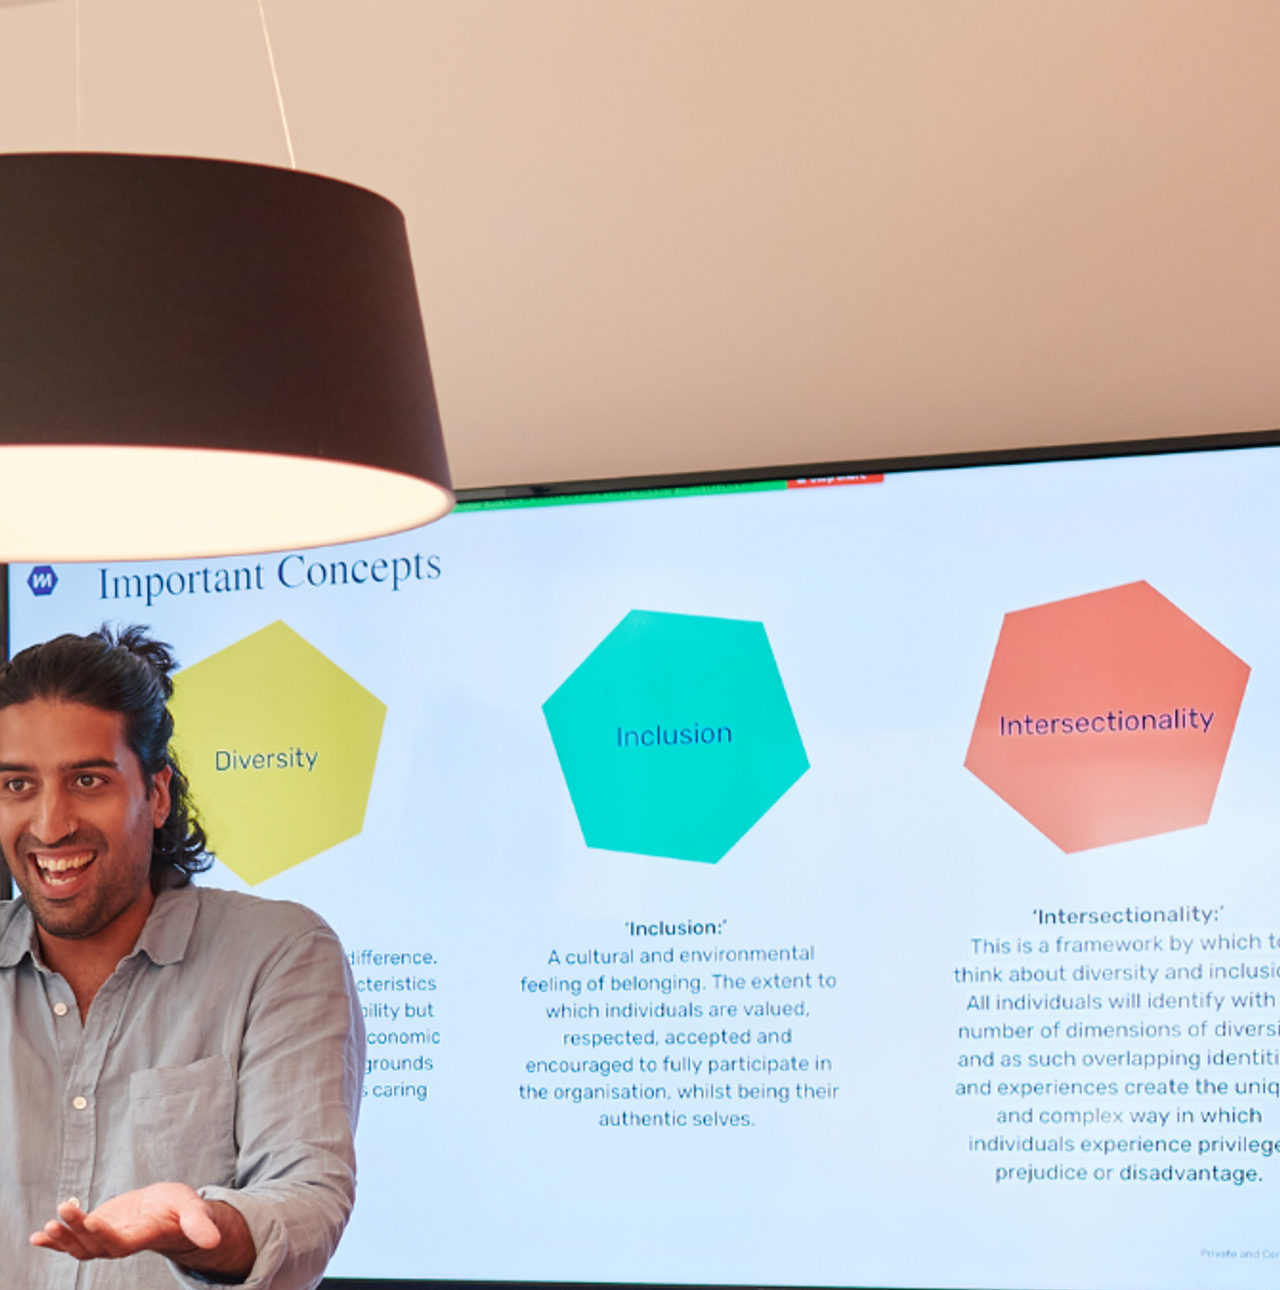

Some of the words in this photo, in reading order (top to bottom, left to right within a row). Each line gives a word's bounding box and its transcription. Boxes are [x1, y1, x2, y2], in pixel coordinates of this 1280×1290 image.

[98, 562, 265, 607] Important
[278, 553, 441, 591] Concepts
[1001, 708, 1214, 736] Intersectionality
[616, 722, 734, 750] Inclusion
[216, 747, 318, 772] Diversity
[971, 938, 1011, 954] This
[1017, 938, 1033, 954] is
[1038, 940, 1049, 954] a
[1056, 936, 1163, 953] framework
[1170, 935, 1194, 954] by
[1200, 933, 1261, 950] which
[548, 950, 561, 965] A
[566, 949, 633, 965] cultural
[640, 948, 673, 964] and
[680, 945, 814, 963] environmental
[954, 967, 1002, 983] think
[1009, 965, 1066, 982] about
[1072, 964, 1159, 984] diversity
[1165, 964, 1203, 980] and
[520, 976, 581, 996] feeling
[587, 975, 605, 992] of
[611, 975, 705, 994] belonging.
[711, 974, 746, 989] The
[751, 973, 812, 989] extent
[818, 973, 837, 988] to
[405, 1003, 434, 1018] but
[546, 1003, 599, 1019] which
[606, 1002, 703, 1018] individuals
[709, 1005, 738, 1017] are
[743, 1001, 810, 1019] valued,
[967, 995, 990, 1010] All
[997, 994, 1102, 1011] individuals
[1108, 993, 1141, 1009] will
[1148, 991, 1225, 1011] identify
[1231, 992, 1275, 1008] with
[564, 1030, 658, 1048] respected,
[665, 1029, 751, 1047] accepted
[757, 1028, 792, 1044] and
[959, 1023, 1034, 1039] number
[1041, 1021, 1061, 1038] of
[1066, 1021, 1181, 1038] dimensions
[1188, 1020, 1208, 1037] of
[526, 1057, 633, 1077] encouraged
[639, 1057, 657, 1073] to
[663, 1055, 702, 1075] fully
[709, 1056, 809, 1075] participate
[816, 1055, 832, 1071] in
[958, 1051, 994, 1067] and
[1000, 1054, 1022, 1067] as
[1028, 1051, 1076, 1067] such
[1082, 1050, 1201, 1071] overlapping
[373, 1081, 427, 1101] caring
[519, 1085, 548, 1099] the
[554, 1084, 671, 1103] organisation,
[677, 1084, 732, 1099] whilst
[738, 1083, 790, 1103] being
[796, 1083, 839, 1099] their
[955, 1080, 991, 1095] and
[997, 1080, 1118, 1098] experiences
[1125, 1079, 1189, 1095] create
[1196, 1079, 1228, 1095] the
[599, 1111, 687, 1126] authentic
[693, 1111, 755, 1126] selves.
[997, 1108, 1033, 1124] and
[1039, 1108, 1123, 1127] complex
[1130, 1110, 1170, 1127] way
[1177, 1107, 1194, 1123] in
[1200, 1107, 1262, 1124] which
[969, 1135, 1075, 1152] individuals
[1081, 1135, 1192, 1155] experience
[996, 1164, 1088, 1183] prejudice
[1093, 1168, 1114, 1181] or
[1120, 1165, 1262, 1186] disadvantage.
